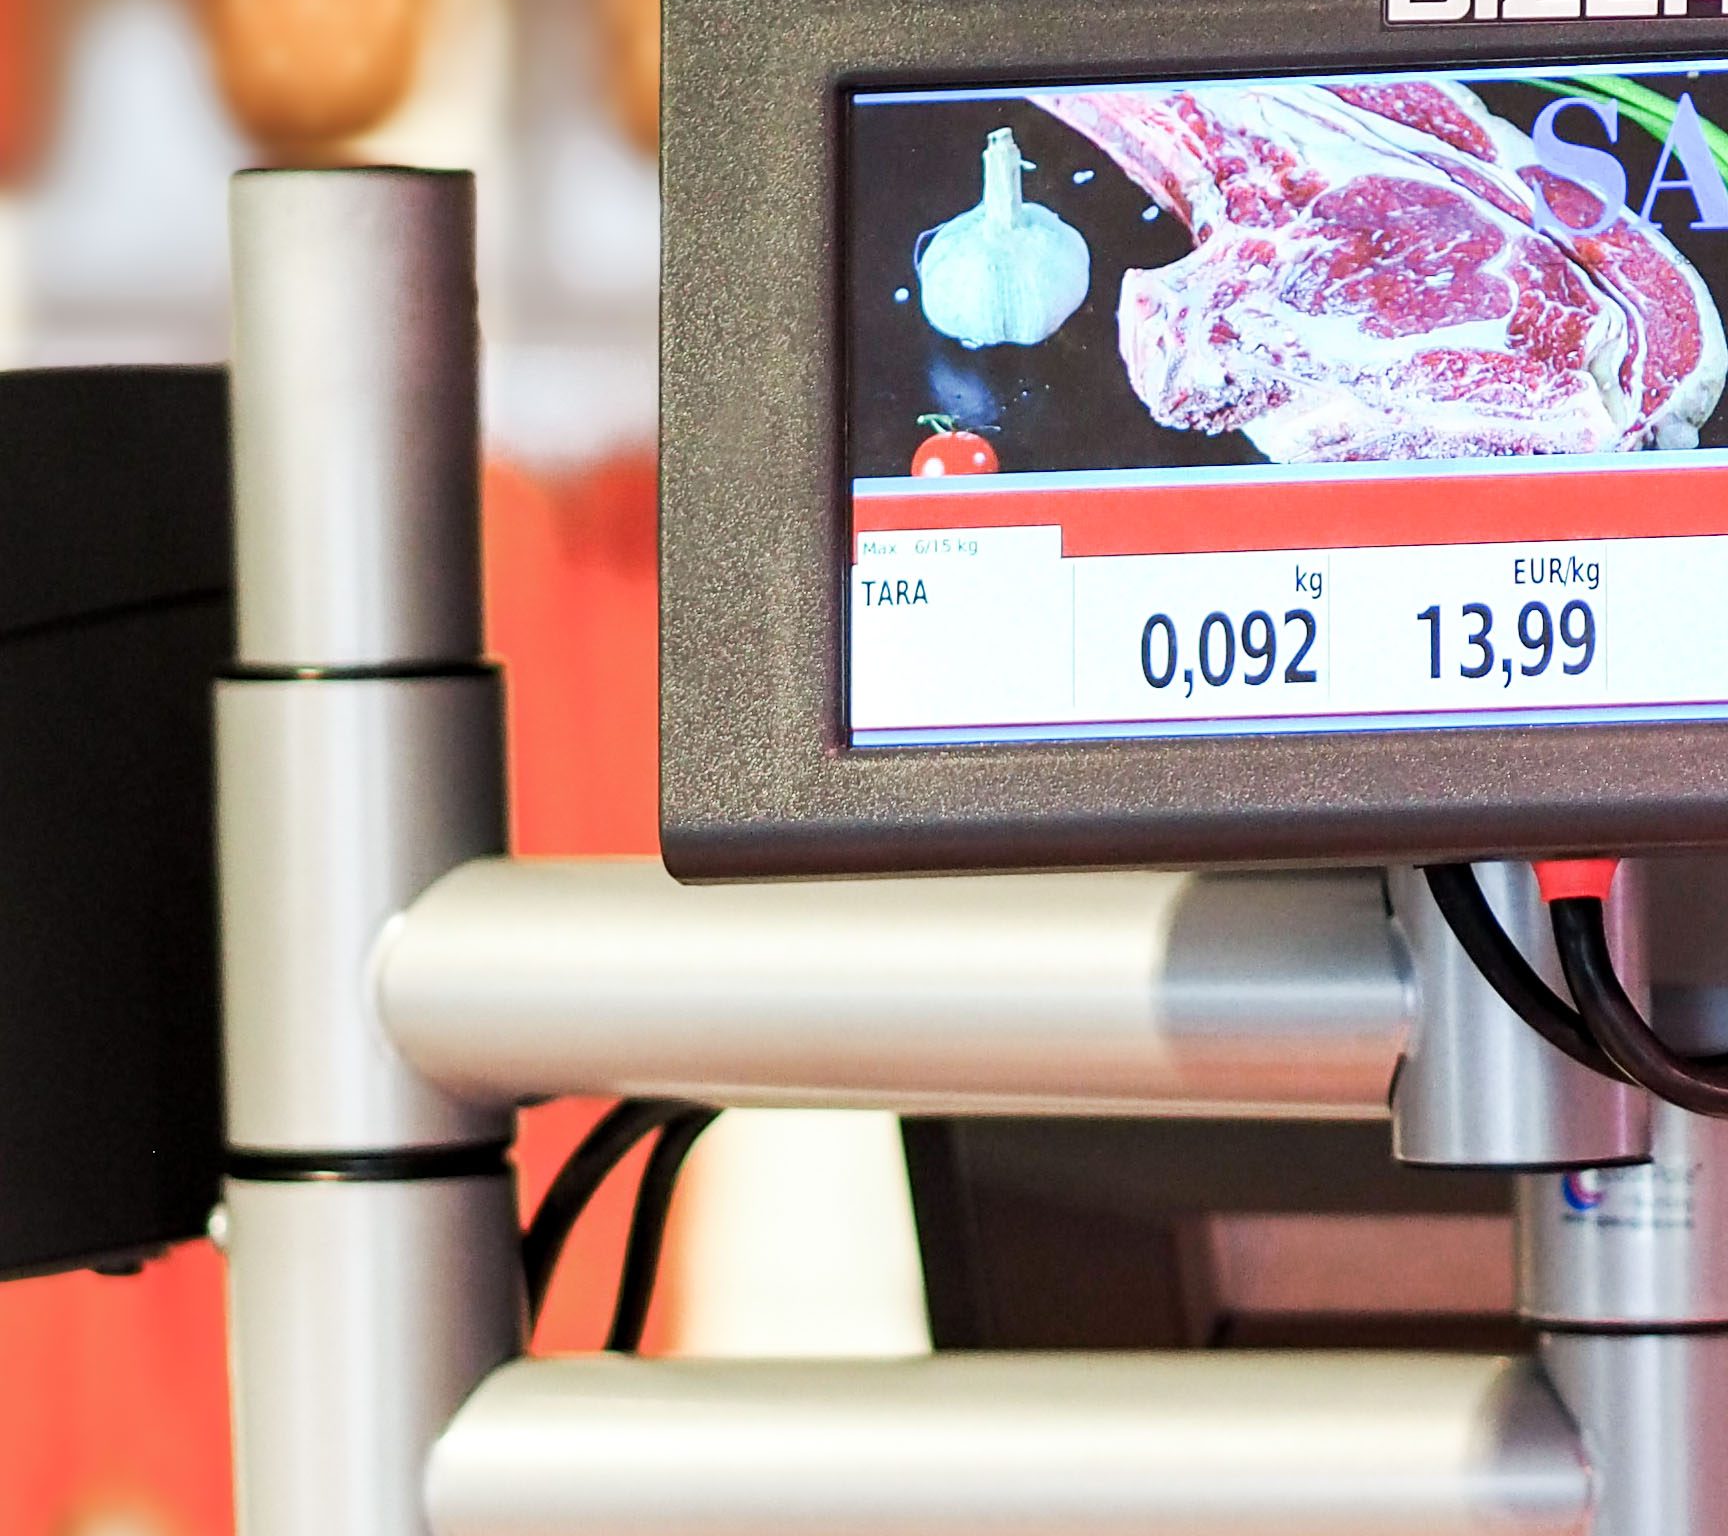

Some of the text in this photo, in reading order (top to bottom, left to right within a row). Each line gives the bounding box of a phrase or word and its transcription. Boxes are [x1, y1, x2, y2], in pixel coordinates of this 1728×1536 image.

[914, 538, 951, 554] 6/15
[957, 538, 978, 556] kg
[1295, 565, 1323, 599] kg
[1514, 555, 1600, 590] EUR/kg
[861, 579, 929, 606] TARA
[1140, 608, 1318, 698] 0,092
[1416, 598, 1597, 688] 13,99
